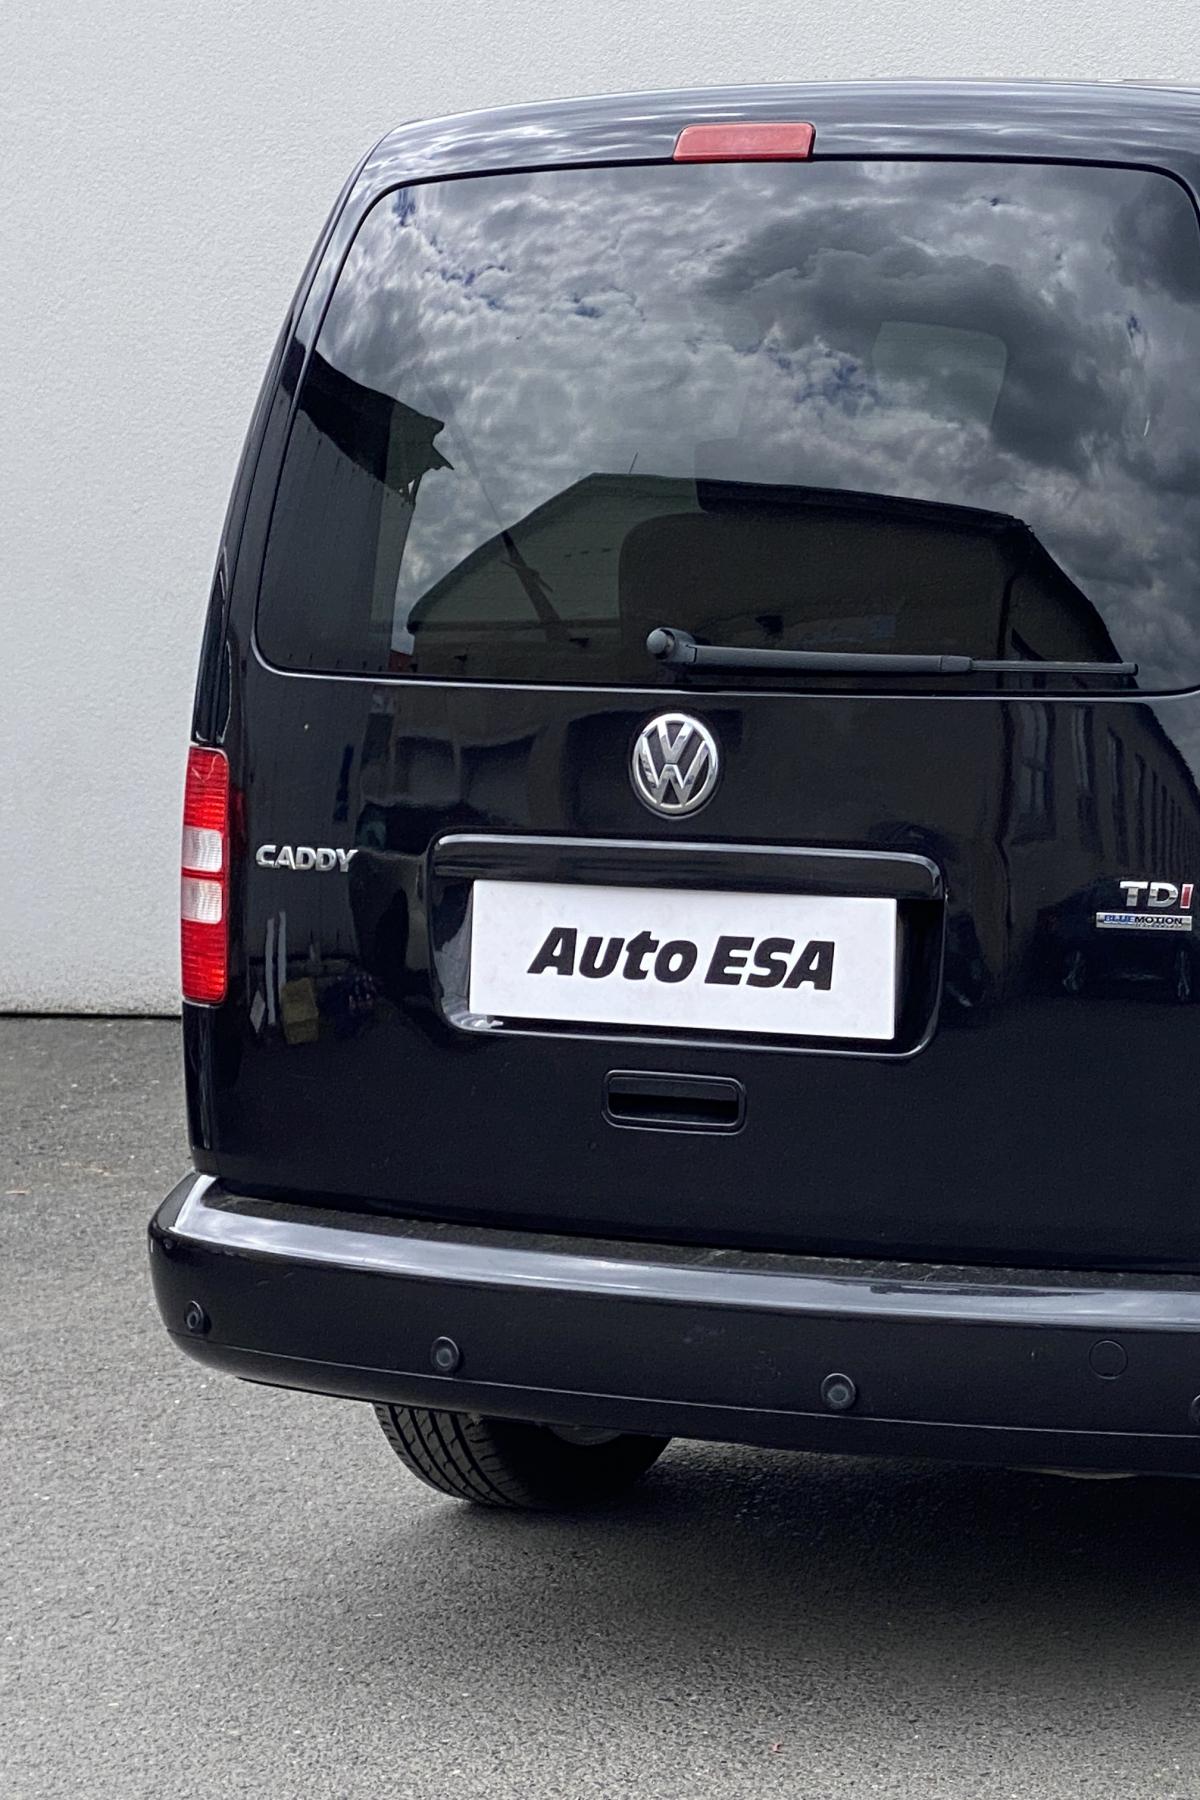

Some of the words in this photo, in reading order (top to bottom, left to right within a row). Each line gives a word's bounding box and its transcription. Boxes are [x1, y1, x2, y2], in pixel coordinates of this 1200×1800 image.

[255, 844, 359, 873] CADDY
[1119, 881, 1194, 909] TDI
[1104, 915, 1183, 925] BLUEMOTION
[527, 927, 698, 983] Auto
[704, 935, 835, 990] ESA
